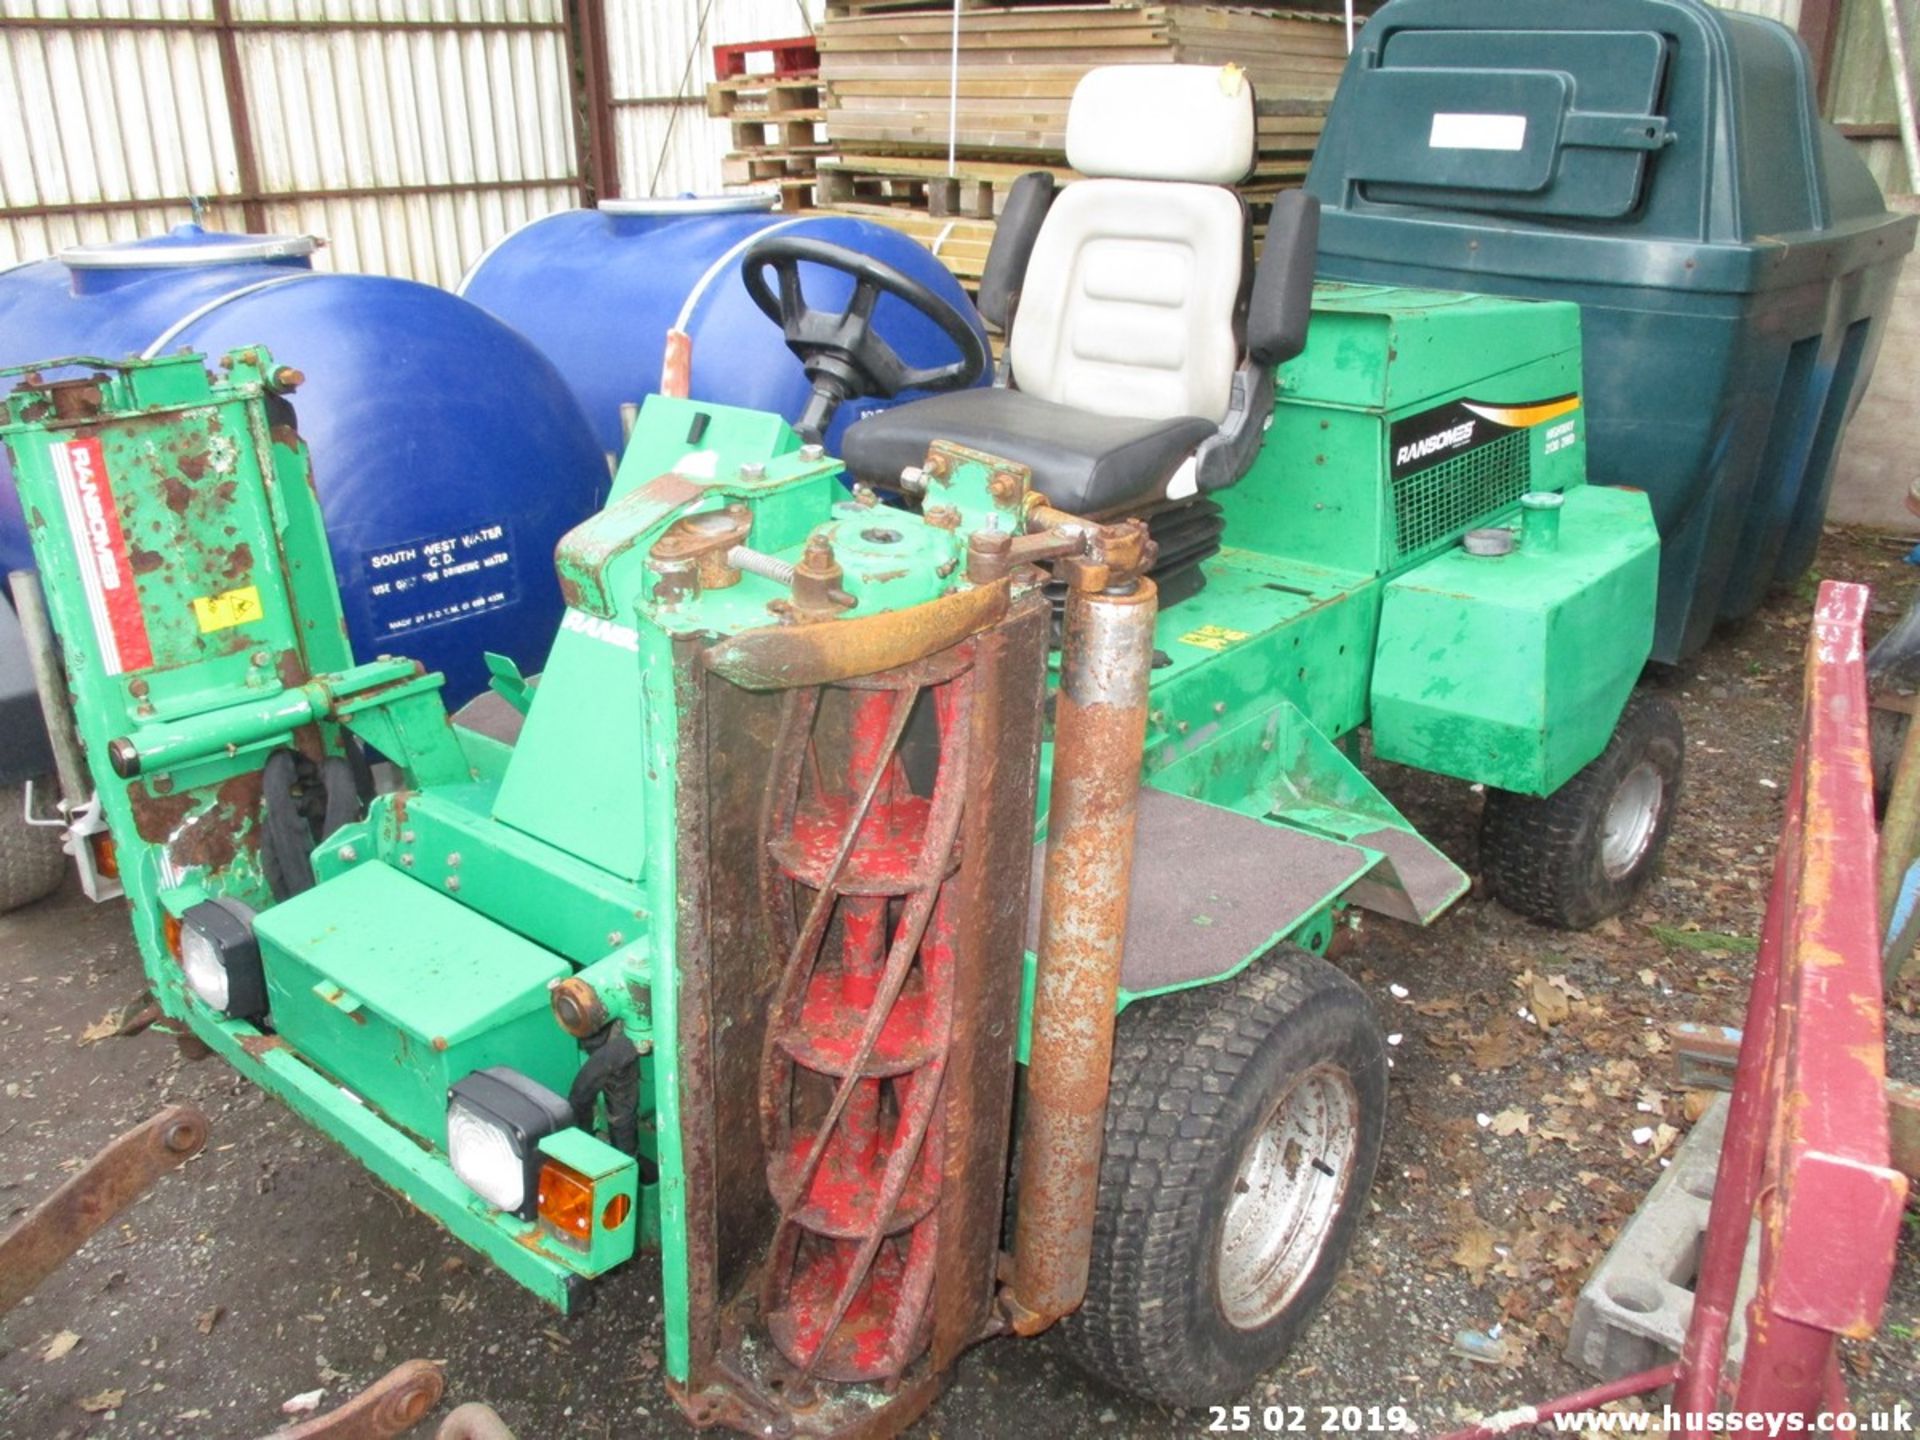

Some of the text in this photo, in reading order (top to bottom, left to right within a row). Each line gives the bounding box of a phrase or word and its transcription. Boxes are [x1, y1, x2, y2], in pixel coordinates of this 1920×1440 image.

[1396, 420, 1476, 466] RANSOMES
[71, 447, 121, 590] RANSOMES
[372, 548, 416, 568] SOUTH
[424, 538, 456, 556] WEST
